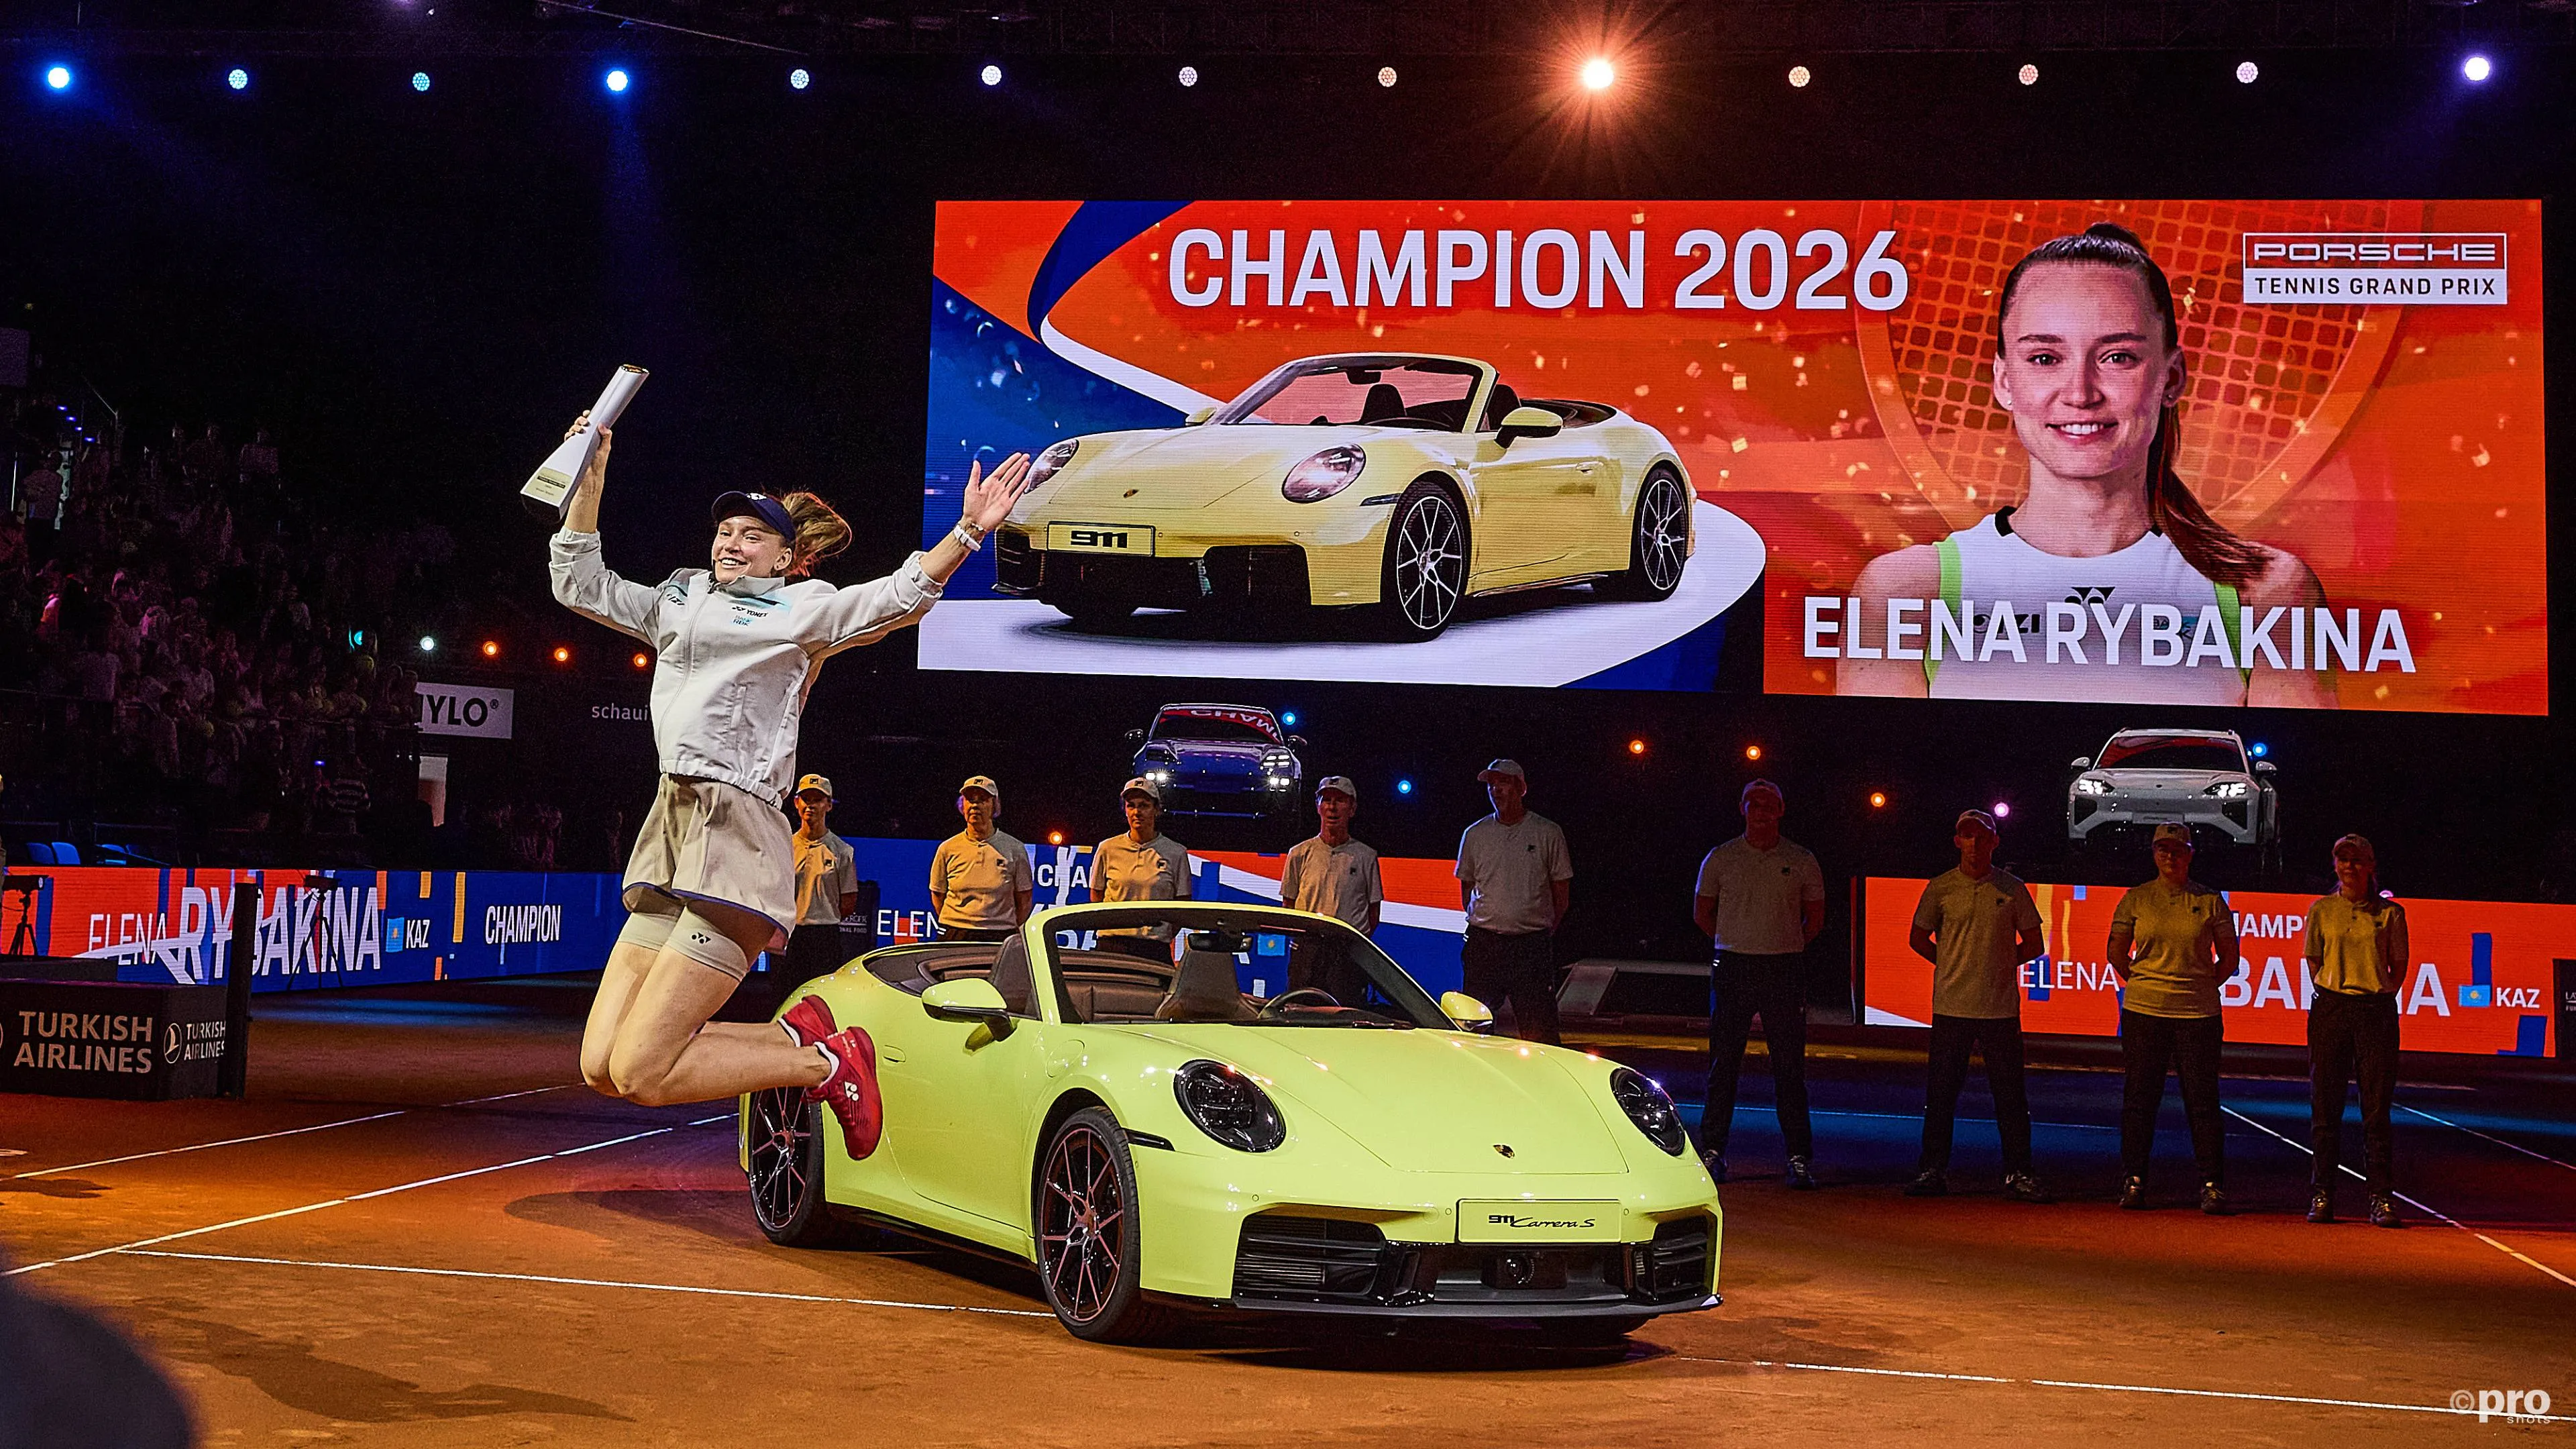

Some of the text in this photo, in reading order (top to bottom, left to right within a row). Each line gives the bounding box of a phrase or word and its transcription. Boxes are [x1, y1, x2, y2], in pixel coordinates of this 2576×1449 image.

[2254, 244, 2496, 261] PORSCHE
[1169, 229, 1909, 311] CHAMPION 2026
[2255, 278, 2495, 295] TENNIS GRAND PRIX
[1071, 530, 1128, 549] 911
[1805, 596, 2416, 673] ELENA RYBAKINA
[592, 702, 651, 721] schaui
[1038, 864, 1093, 888] CHA
[485, 904, 561, 945] CHAMPION
[89, 913, 166, 965] ELENA
[407, 919, 431, 949] KAZ
[2020, 960, 2120, 991] ELENA
[2496, 987, 2540, 1008] KAZ
[19, 1011, 153, 1042] TURKISH
[186, 1020, 226, 1040] TURKISH
[13, 1042, 152, 1073] AIRLINES
[1489, 1215, 1595, 1228] 911 Carrera S
